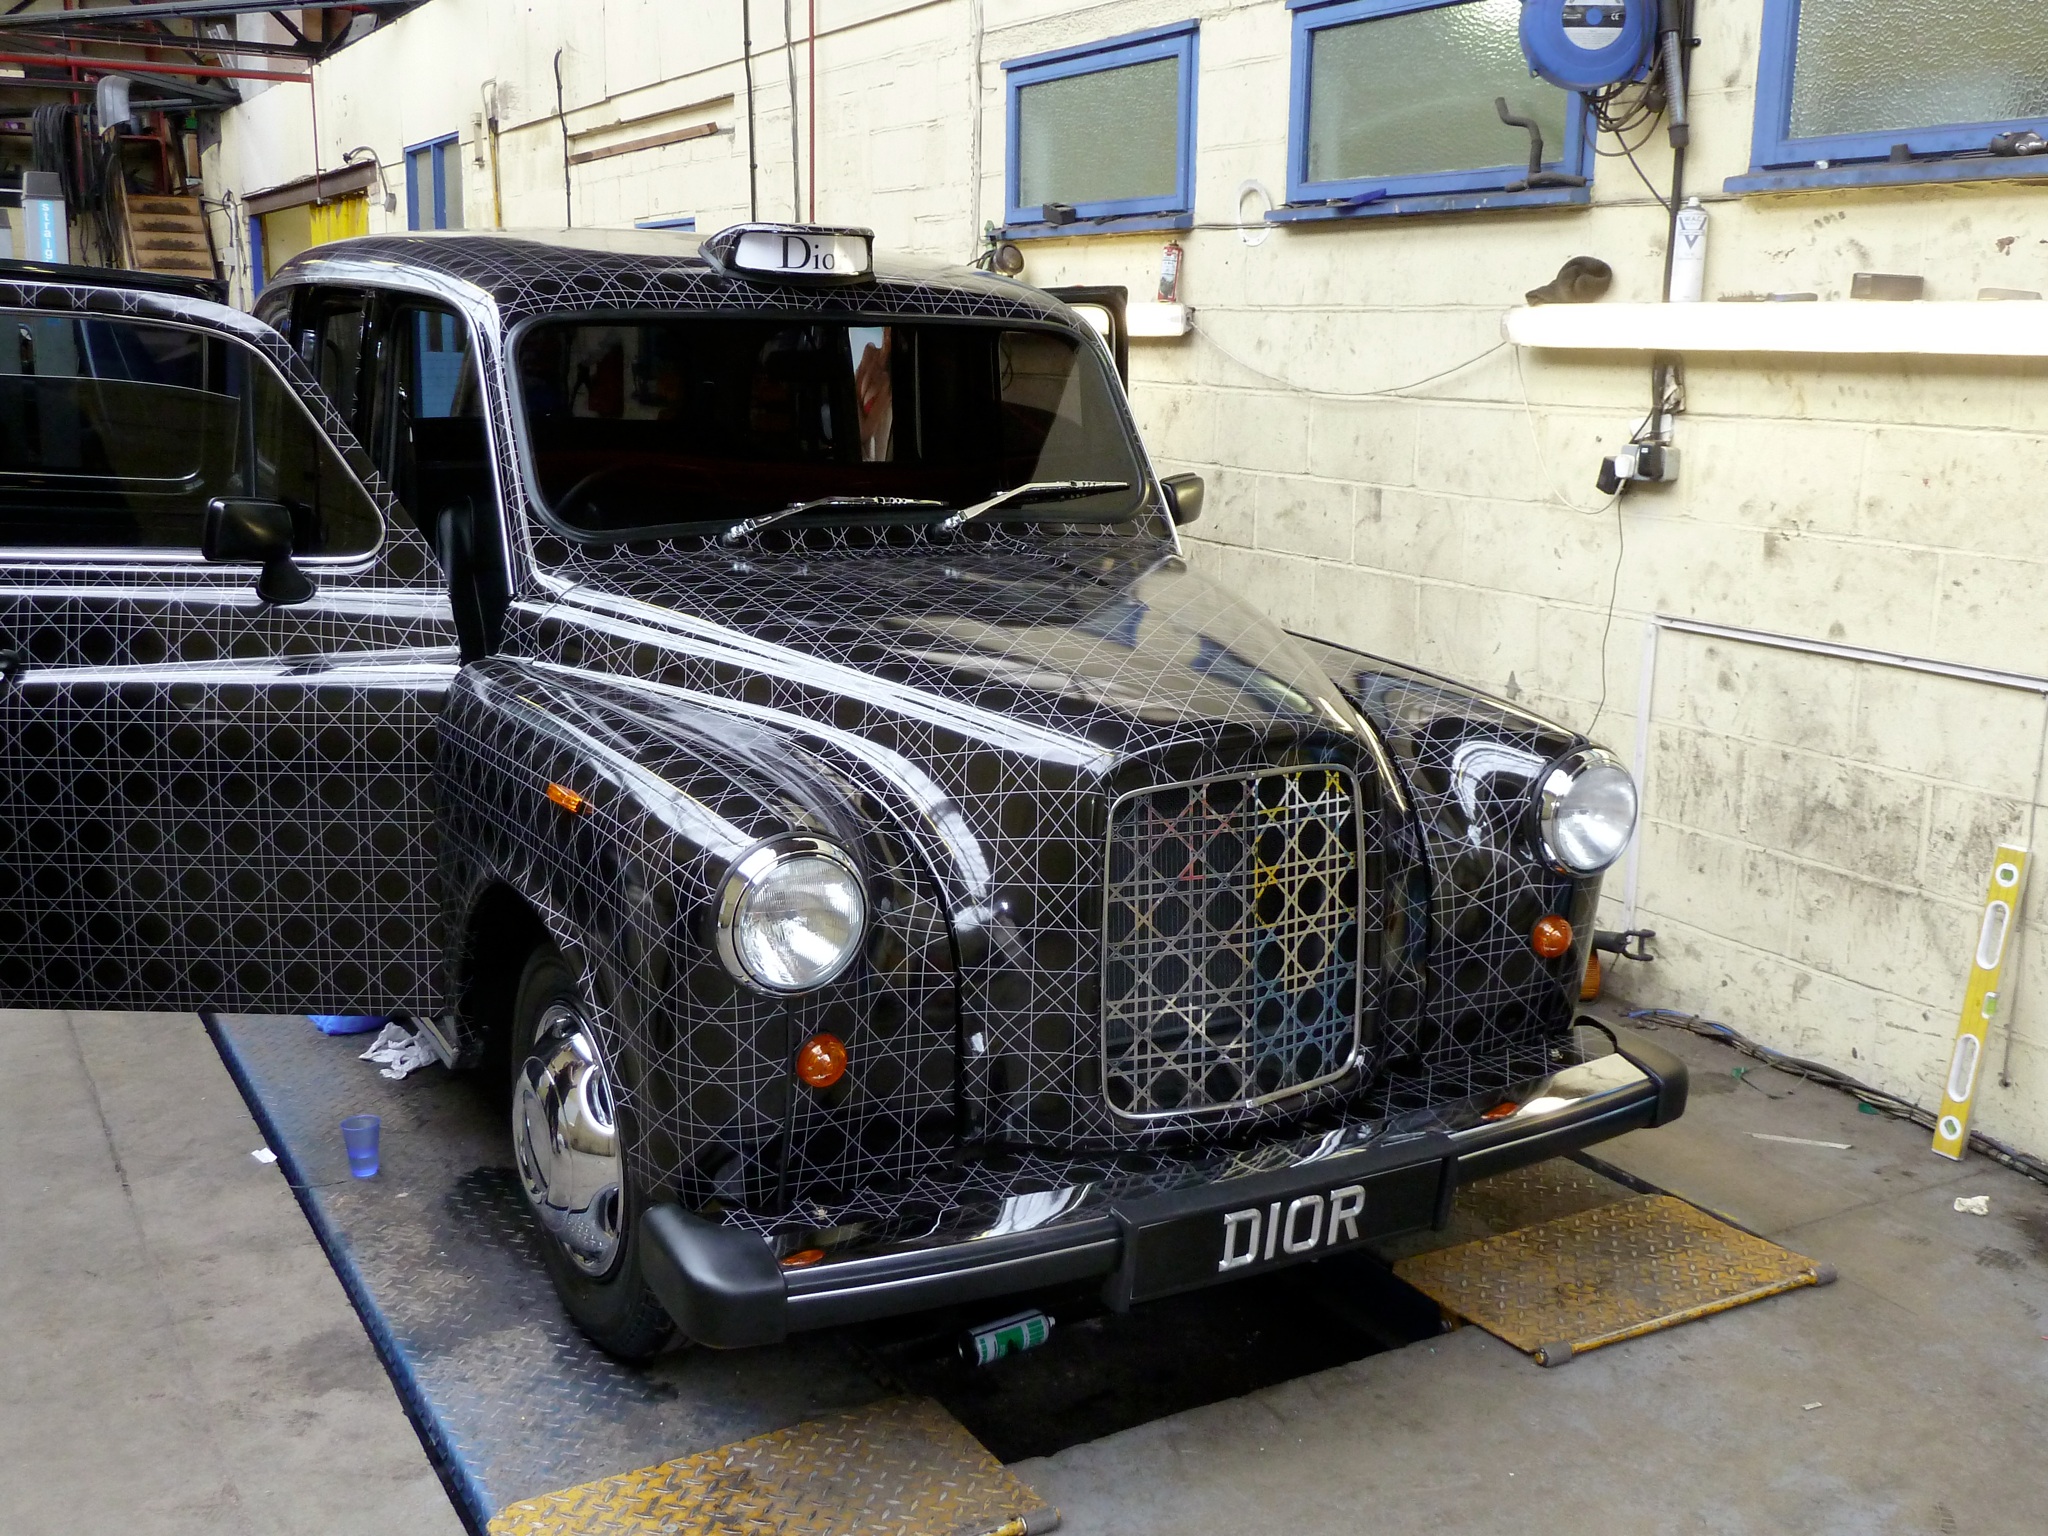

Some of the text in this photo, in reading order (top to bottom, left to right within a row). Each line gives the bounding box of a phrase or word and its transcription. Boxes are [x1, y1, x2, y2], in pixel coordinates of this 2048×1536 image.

[42, 203, 54, 263] straig
[776, 235, 846, 271] Dio
[1218, 1184, 1366, 1272] DIOR
